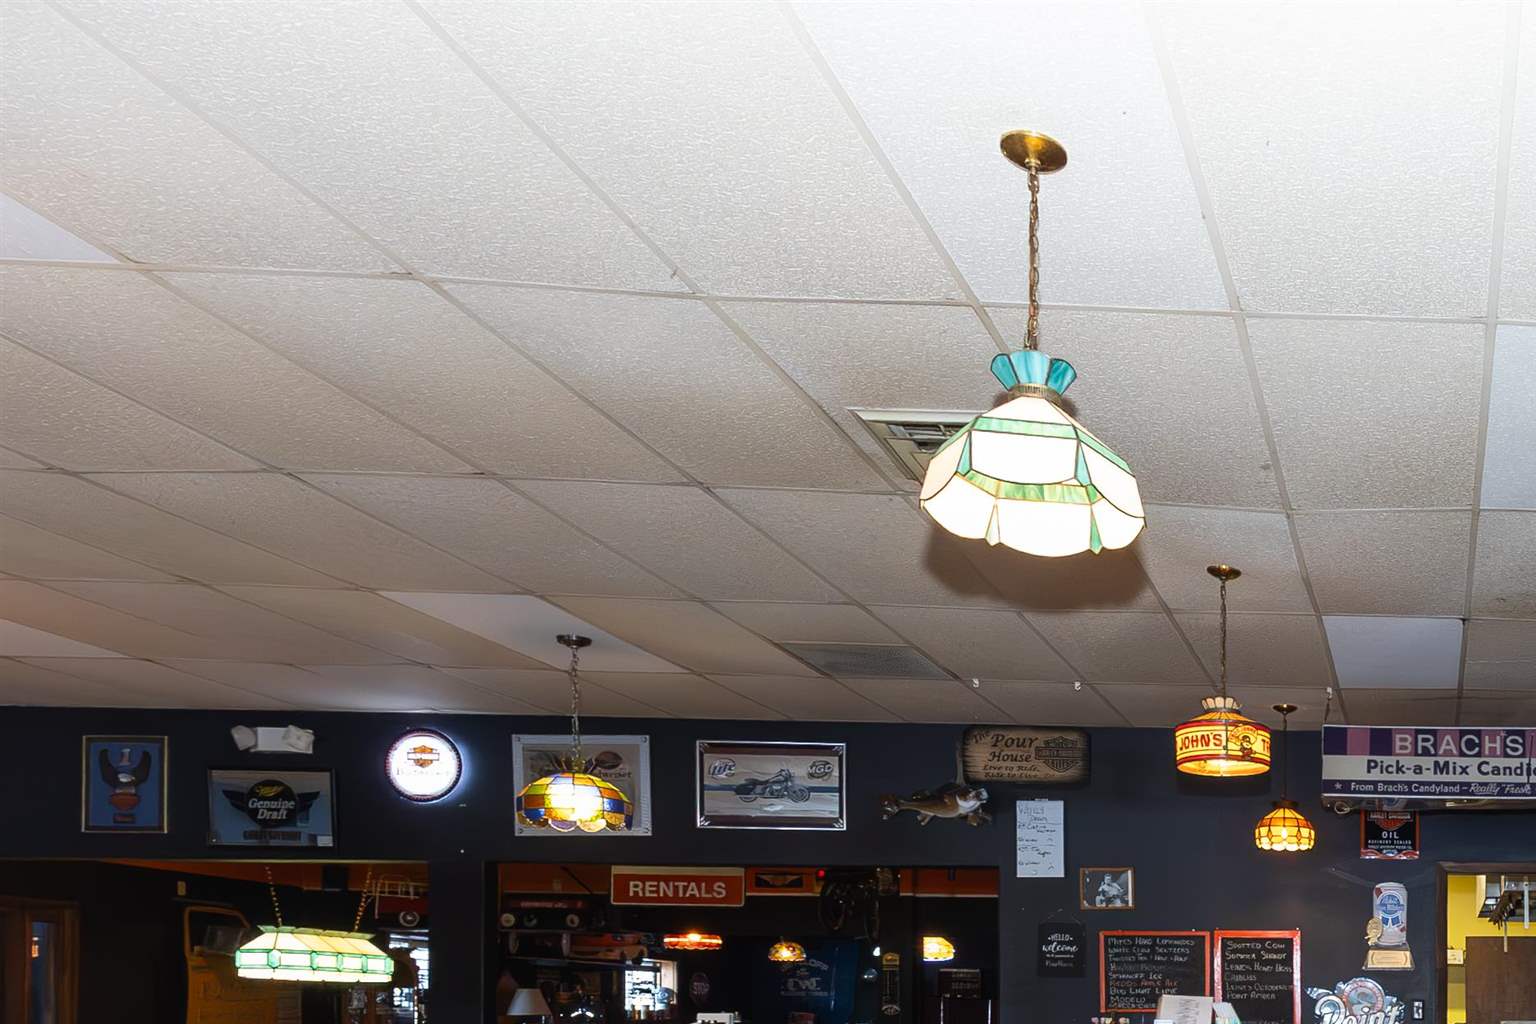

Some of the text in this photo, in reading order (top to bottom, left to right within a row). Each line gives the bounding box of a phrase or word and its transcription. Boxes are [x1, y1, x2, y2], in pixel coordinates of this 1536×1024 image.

[991, 733, 1039, 748] Pour
[1179, 732, 1223, 751] JOHN'S
[1395, 734, 1524, 756] BRACH'S
[988, 751, 1032, 763] House
[807, 761, 833, 777] MGD
[1366, 759, 1470, 776] Pick-a-Mix
[1351, 782, 1374, 793] From
[1377, 782, 1409, 793] Brach's
[1411, 783, 1460, 794] Candyland
[248, 798, 295, 808] Genuine
[257, 809, 288, 819] Draft
[1382, 831, 1400, 839] OIL
[628, 880, 727, 899] RENTALS
[1042, 941, 1079, 952] welcome
